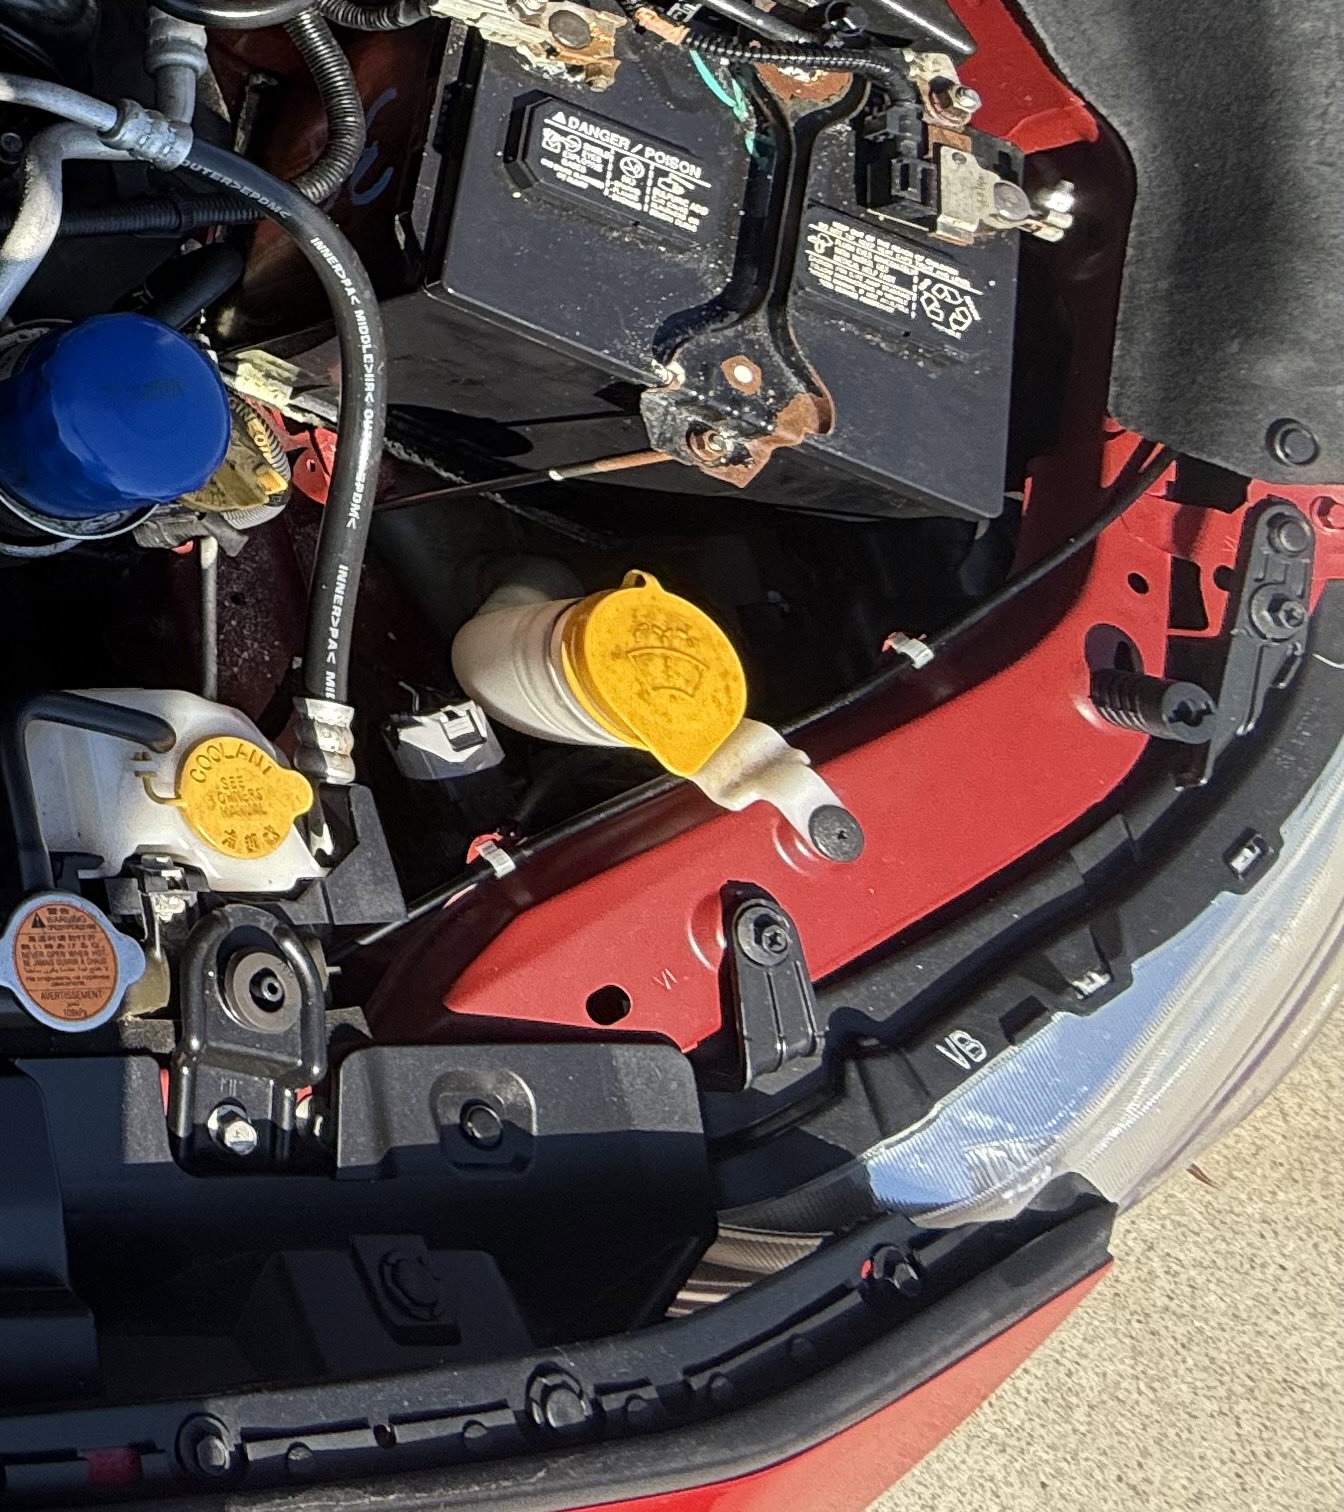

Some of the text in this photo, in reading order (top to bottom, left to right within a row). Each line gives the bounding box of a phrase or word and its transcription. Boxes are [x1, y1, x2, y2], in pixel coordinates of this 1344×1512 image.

[568, 116, 631, 150] DANGER
[644, 147, 702, 179] POISON
[325, 564, 349, 665] INNER>PA<
[189, 741, 273, 784] COOLANT
[220, 775, 246, 790] SEE
[47, 950, 66, 958] OPEN
[69, 950, 89, 958] WHEN
[41, 990, 103, 1000] AVERTISSEMENT
[935, 1030, 988, 1070] VB
